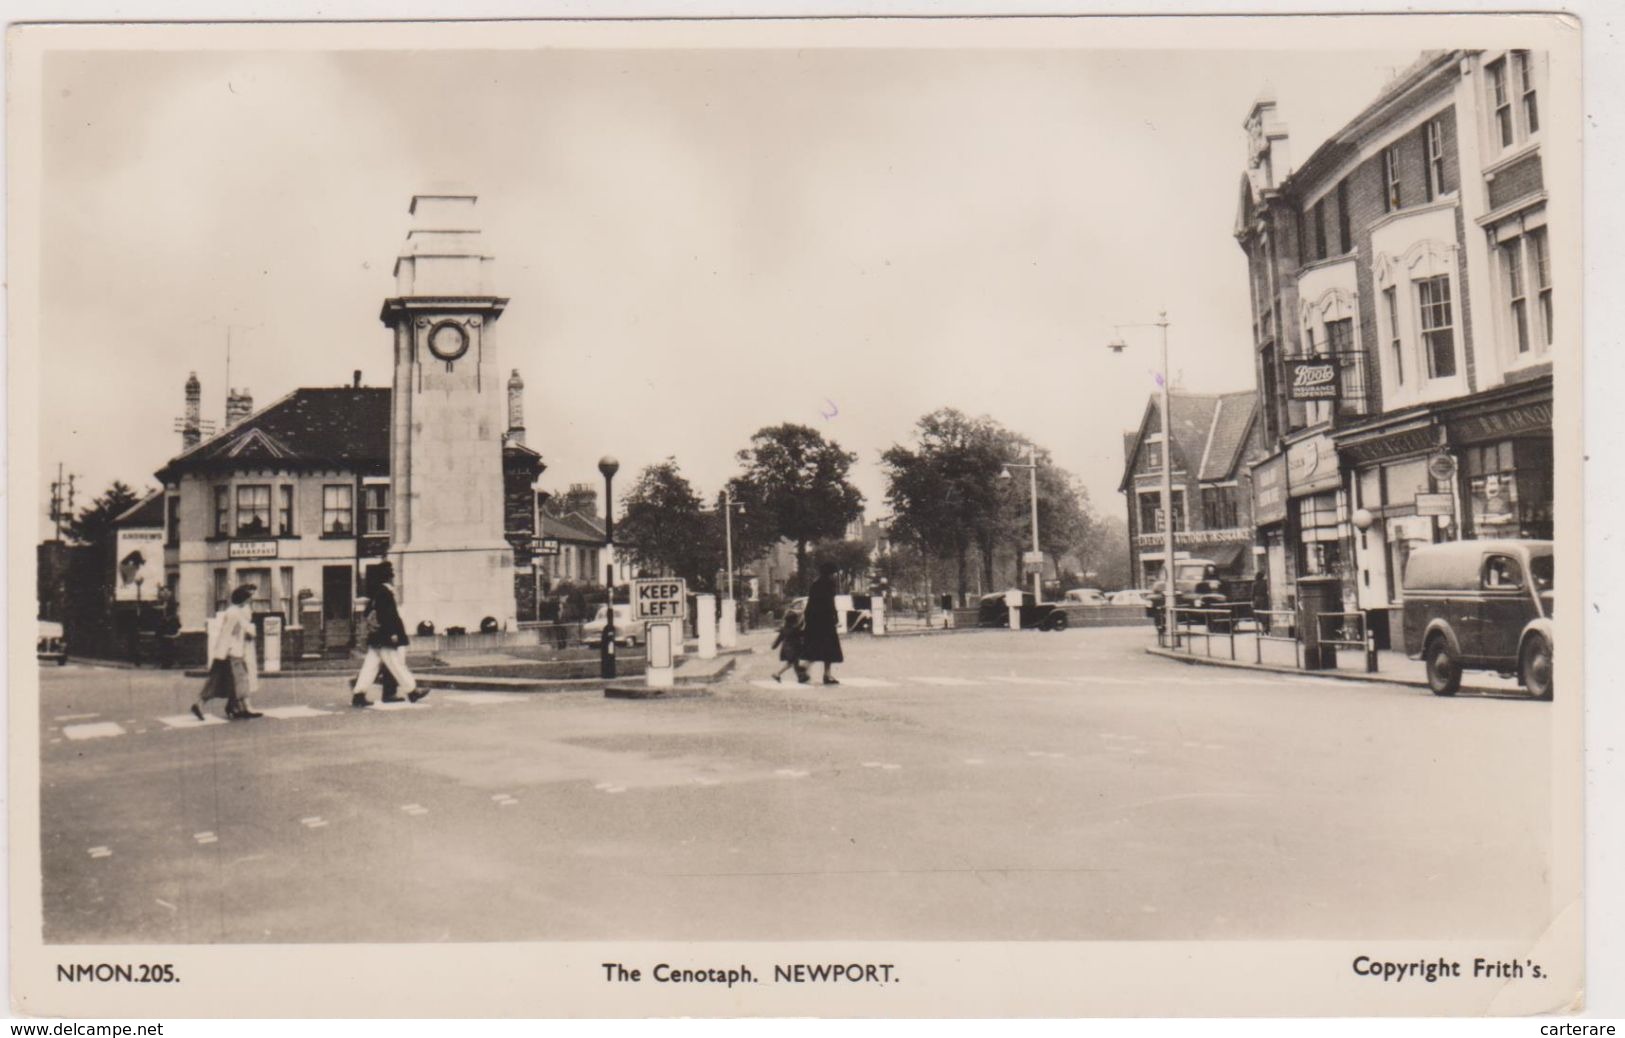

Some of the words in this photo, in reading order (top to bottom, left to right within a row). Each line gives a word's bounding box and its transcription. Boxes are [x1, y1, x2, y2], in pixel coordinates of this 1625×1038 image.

[1293, 365, 1335, 386] Boots
[1293, 385, 1336, 393] INSURANCE
[122, 533, 163, 541] ANDREWS
[232, 548, 275, 556] BREAKFAST
[639, 584, 679, 600] KEEP
[640, 601, 680, 616] LEFT
